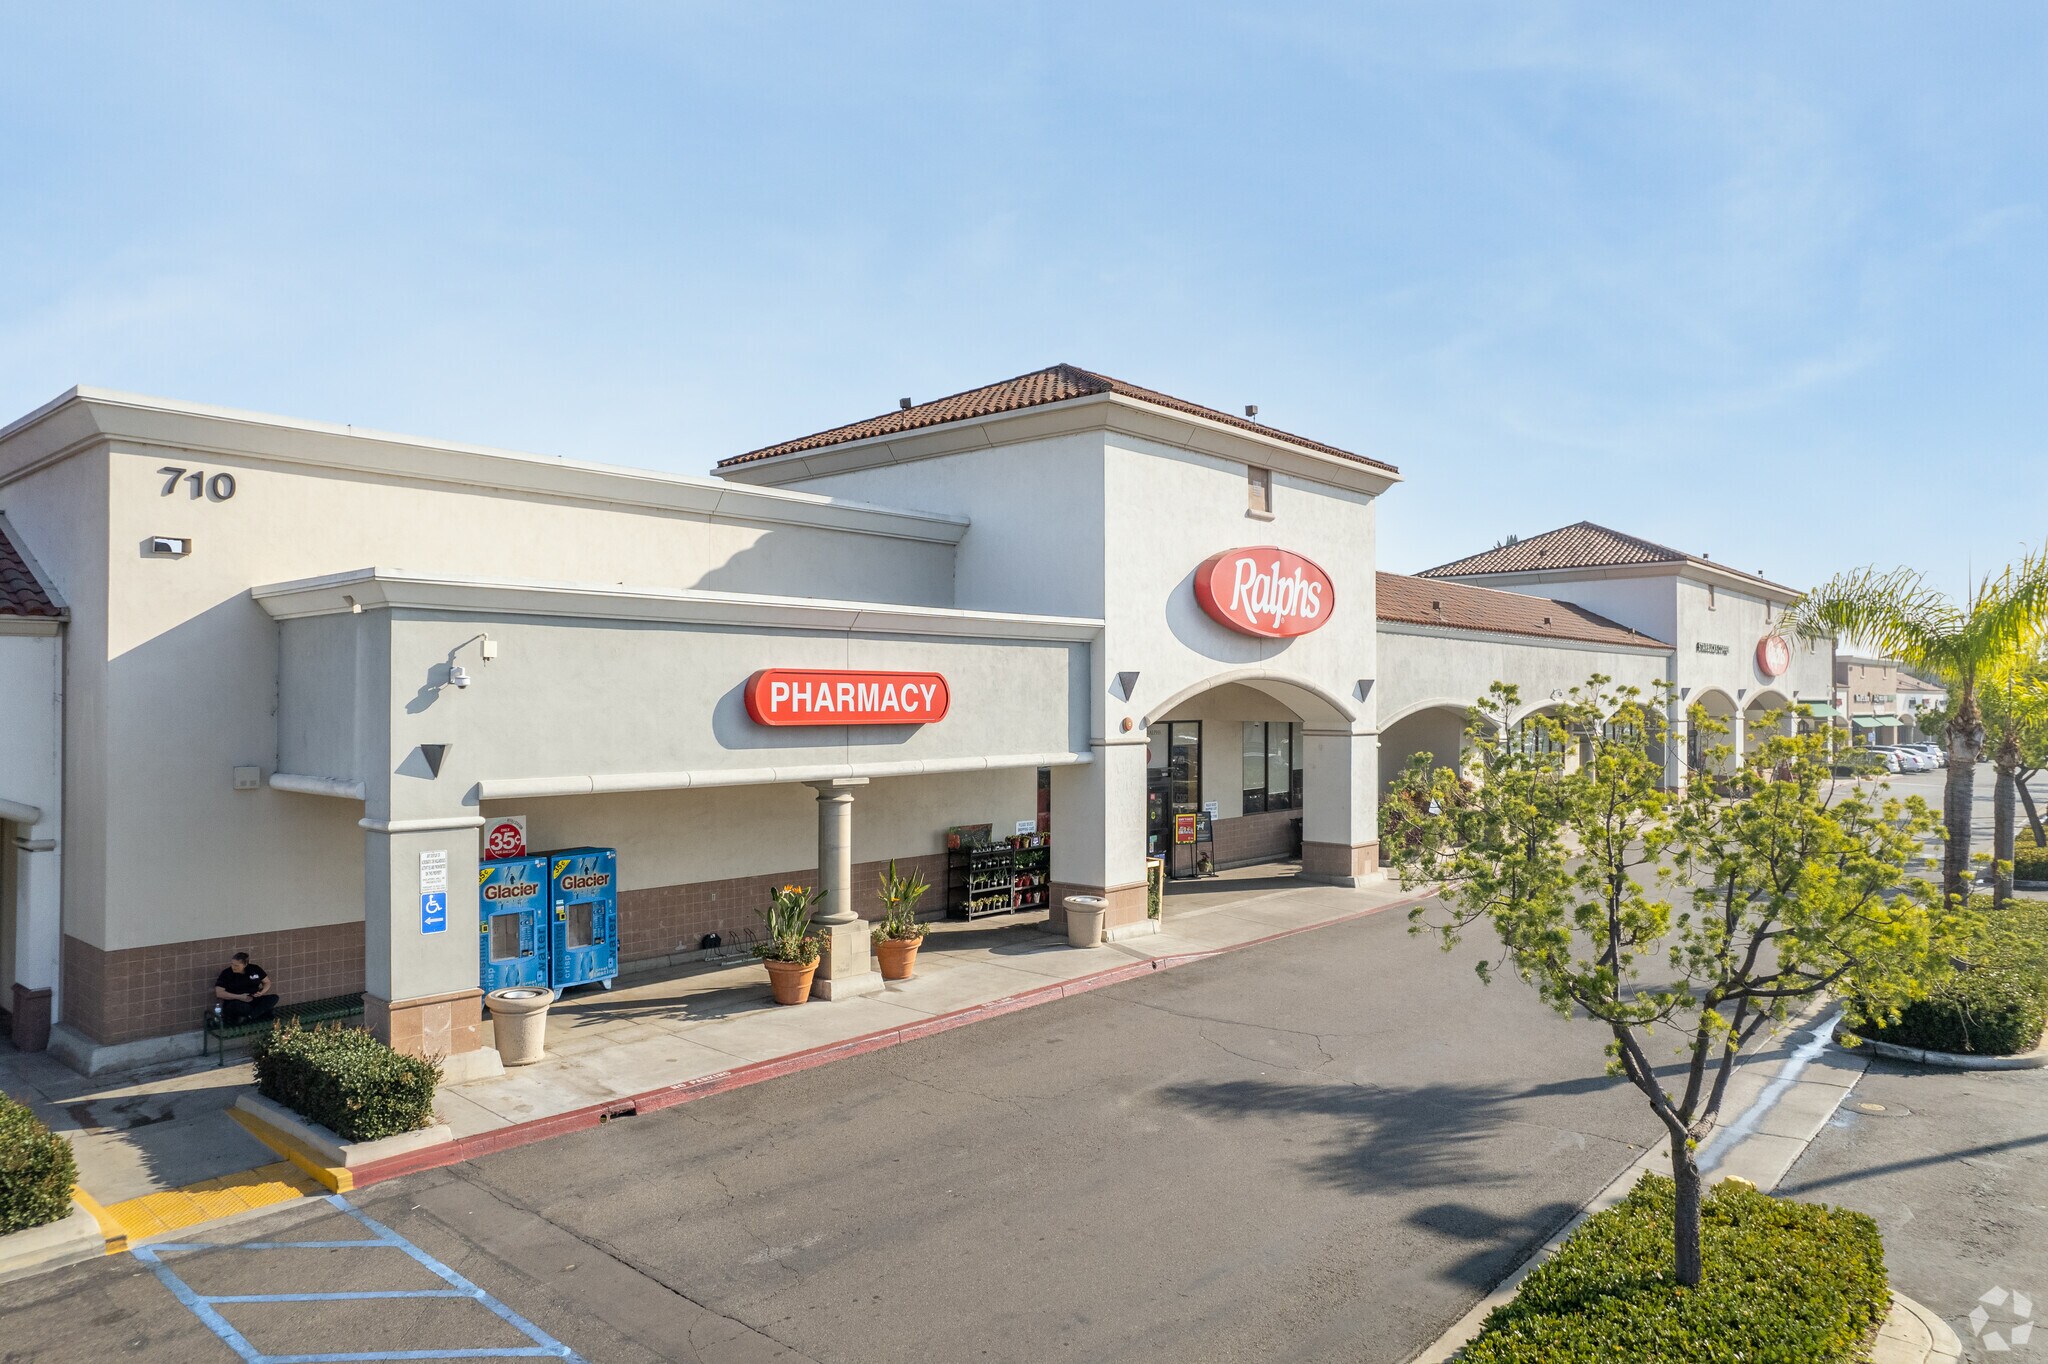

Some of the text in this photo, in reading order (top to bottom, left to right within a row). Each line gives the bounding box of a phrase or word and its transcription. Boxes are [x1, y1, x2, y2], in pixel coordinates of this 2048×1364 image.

[160, 466, 236, 501] 710
[1229, 558, 1321, 628] Ralphs
[770, 681, 936, 712] PHARMACY
[490, 832, 521, 851] 35¢
[484, 883, 538, 900] Glacier
[562, 874, 610, 890] Glacier
[537, 928, 546, 973] water
[608, 916, 616, 960] water
[487, 967, 495, 992] crisp
[689, 1071, 731, 1085] PARKING
